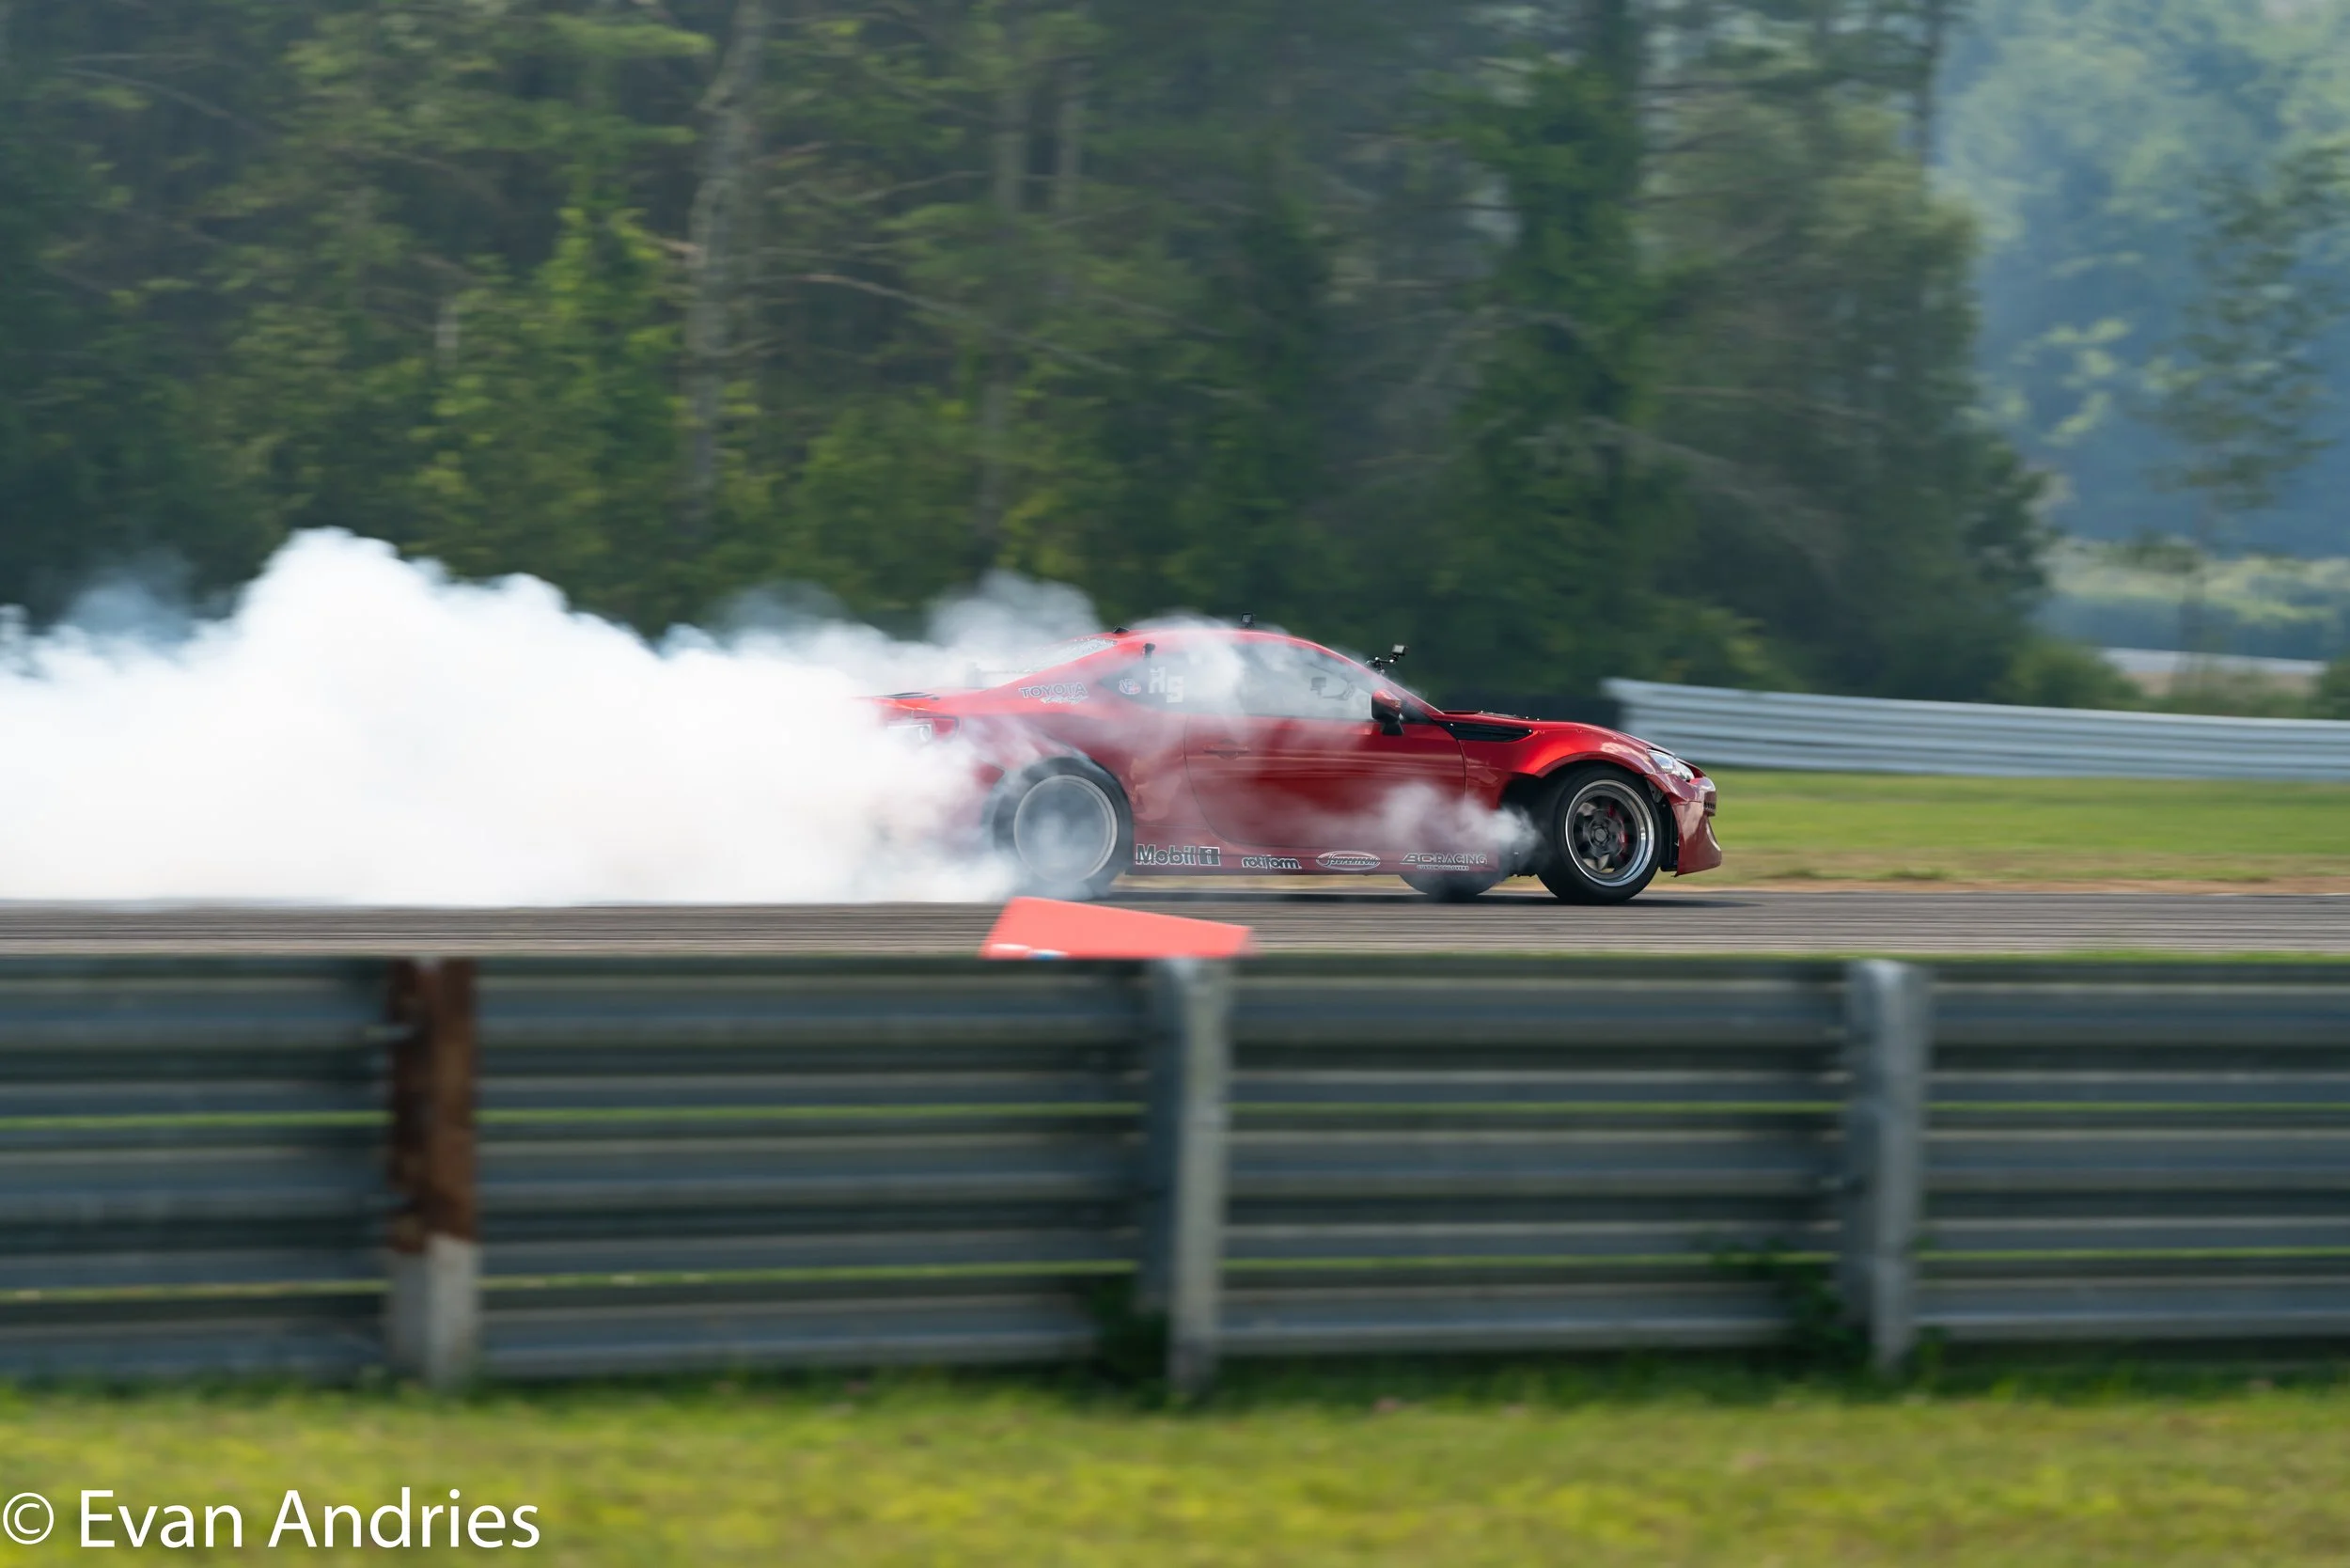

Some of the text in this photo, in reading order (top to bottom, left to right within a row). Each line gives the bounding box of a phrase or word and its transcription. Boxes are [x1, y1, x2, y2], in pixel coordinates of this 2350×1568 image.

[1019, 682, 1088, 698] TOYOTA
[1136, 844, 1196, 866] Mobil
[1434, 854, 1487, 865] RACING
